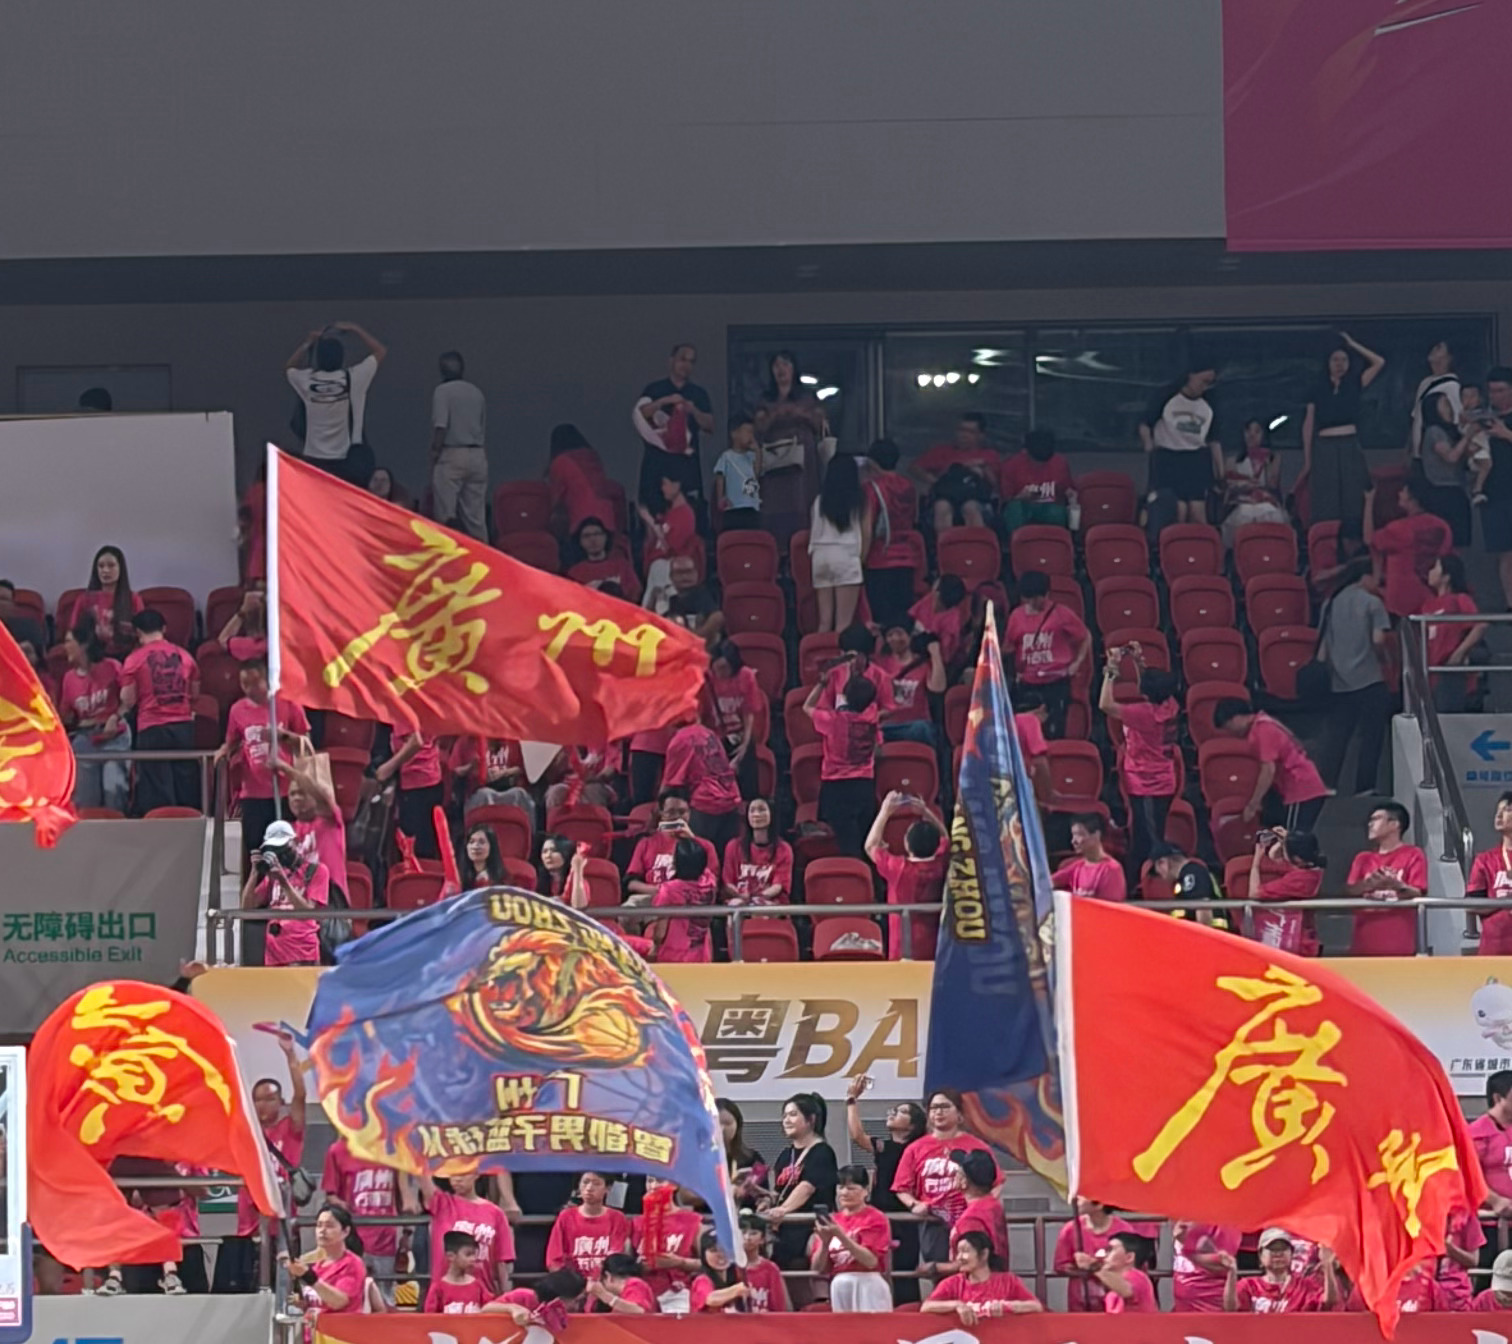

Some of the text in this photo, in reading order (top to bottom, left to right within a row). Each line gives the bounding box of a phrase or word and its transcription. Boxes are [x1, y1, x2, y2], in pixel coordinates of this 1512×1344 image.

[3, 912, 157, 941] 无障碍出口
[3, 945, 143, 964] Accessible Exit
[701, 994, 922, 1084] 粤BA
